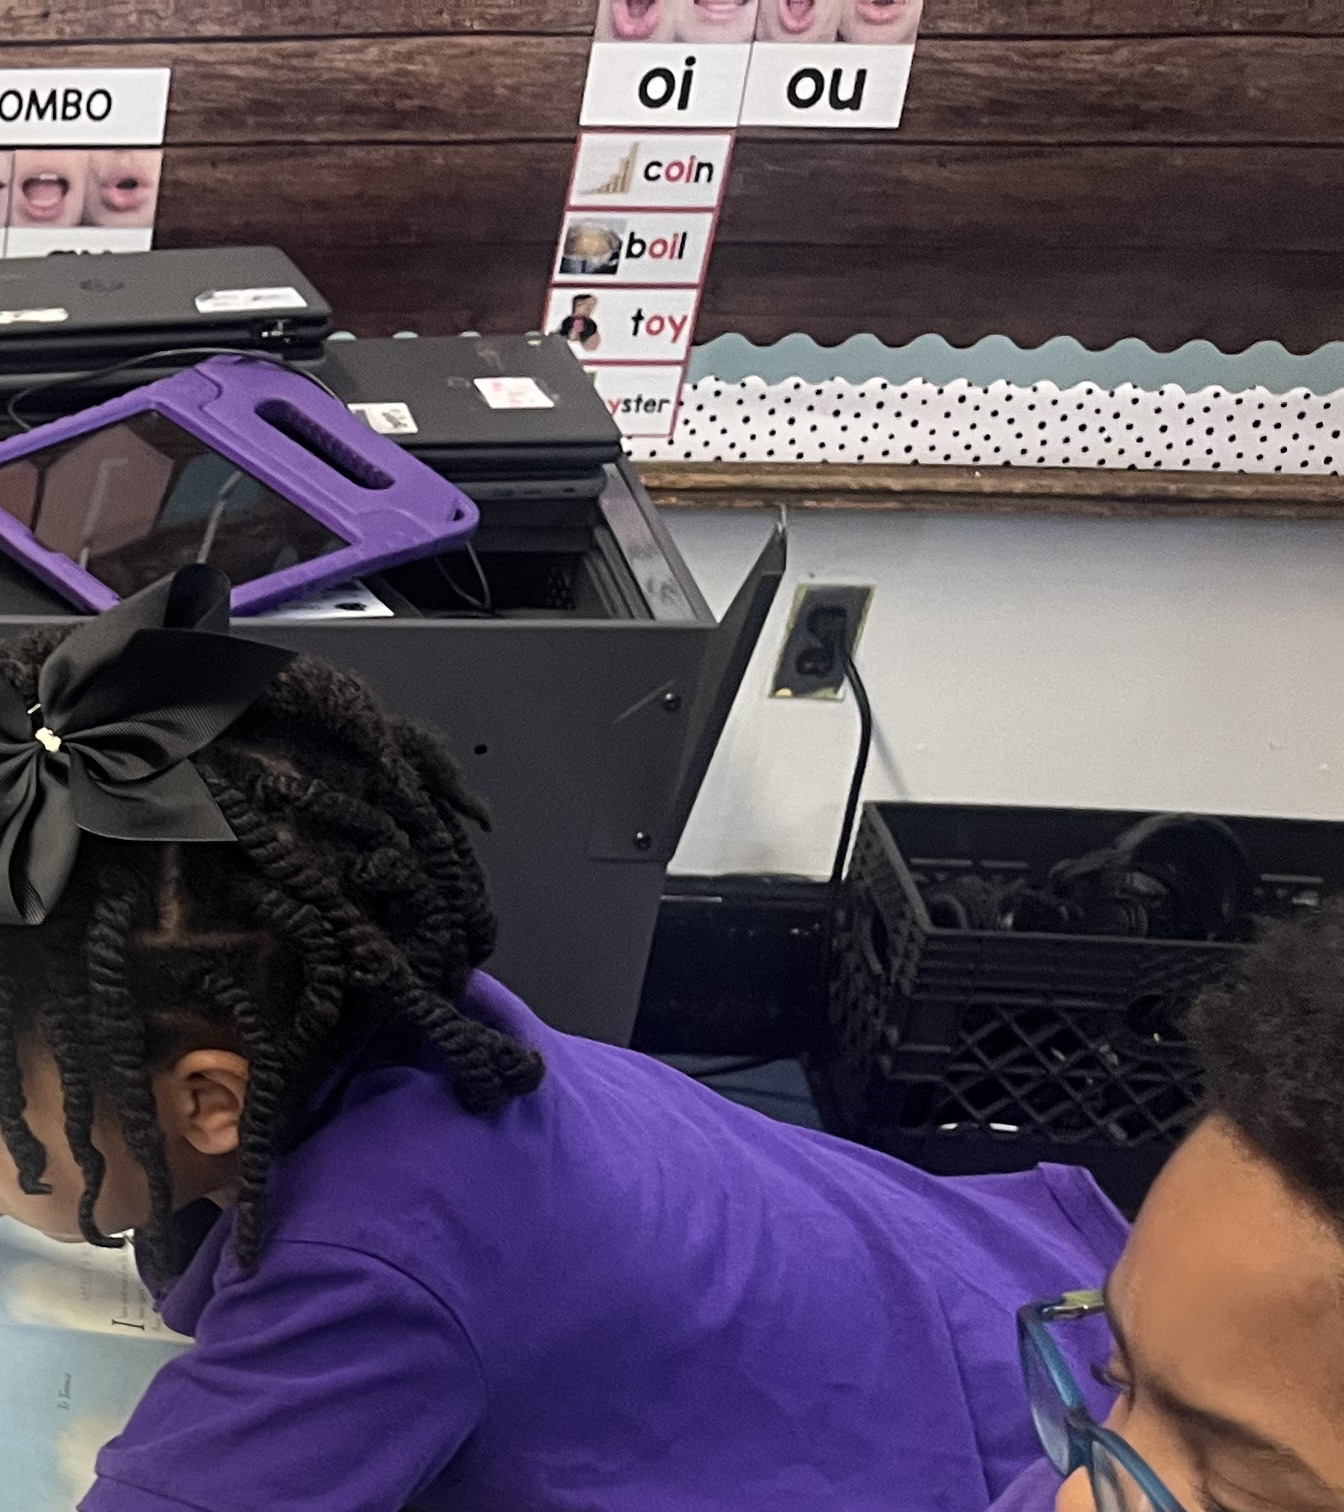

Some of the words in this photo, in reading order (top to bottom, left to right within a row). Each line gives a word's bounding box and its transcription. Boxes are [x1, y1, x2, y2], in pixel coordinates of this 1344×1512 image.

[638, 56, 697, 111] oi
[786, 67, 867, 111] ou
[643, 154, 713, 184] coin
[625, 231, 687, 260] boil
[631, 310, 689, 343] toy
